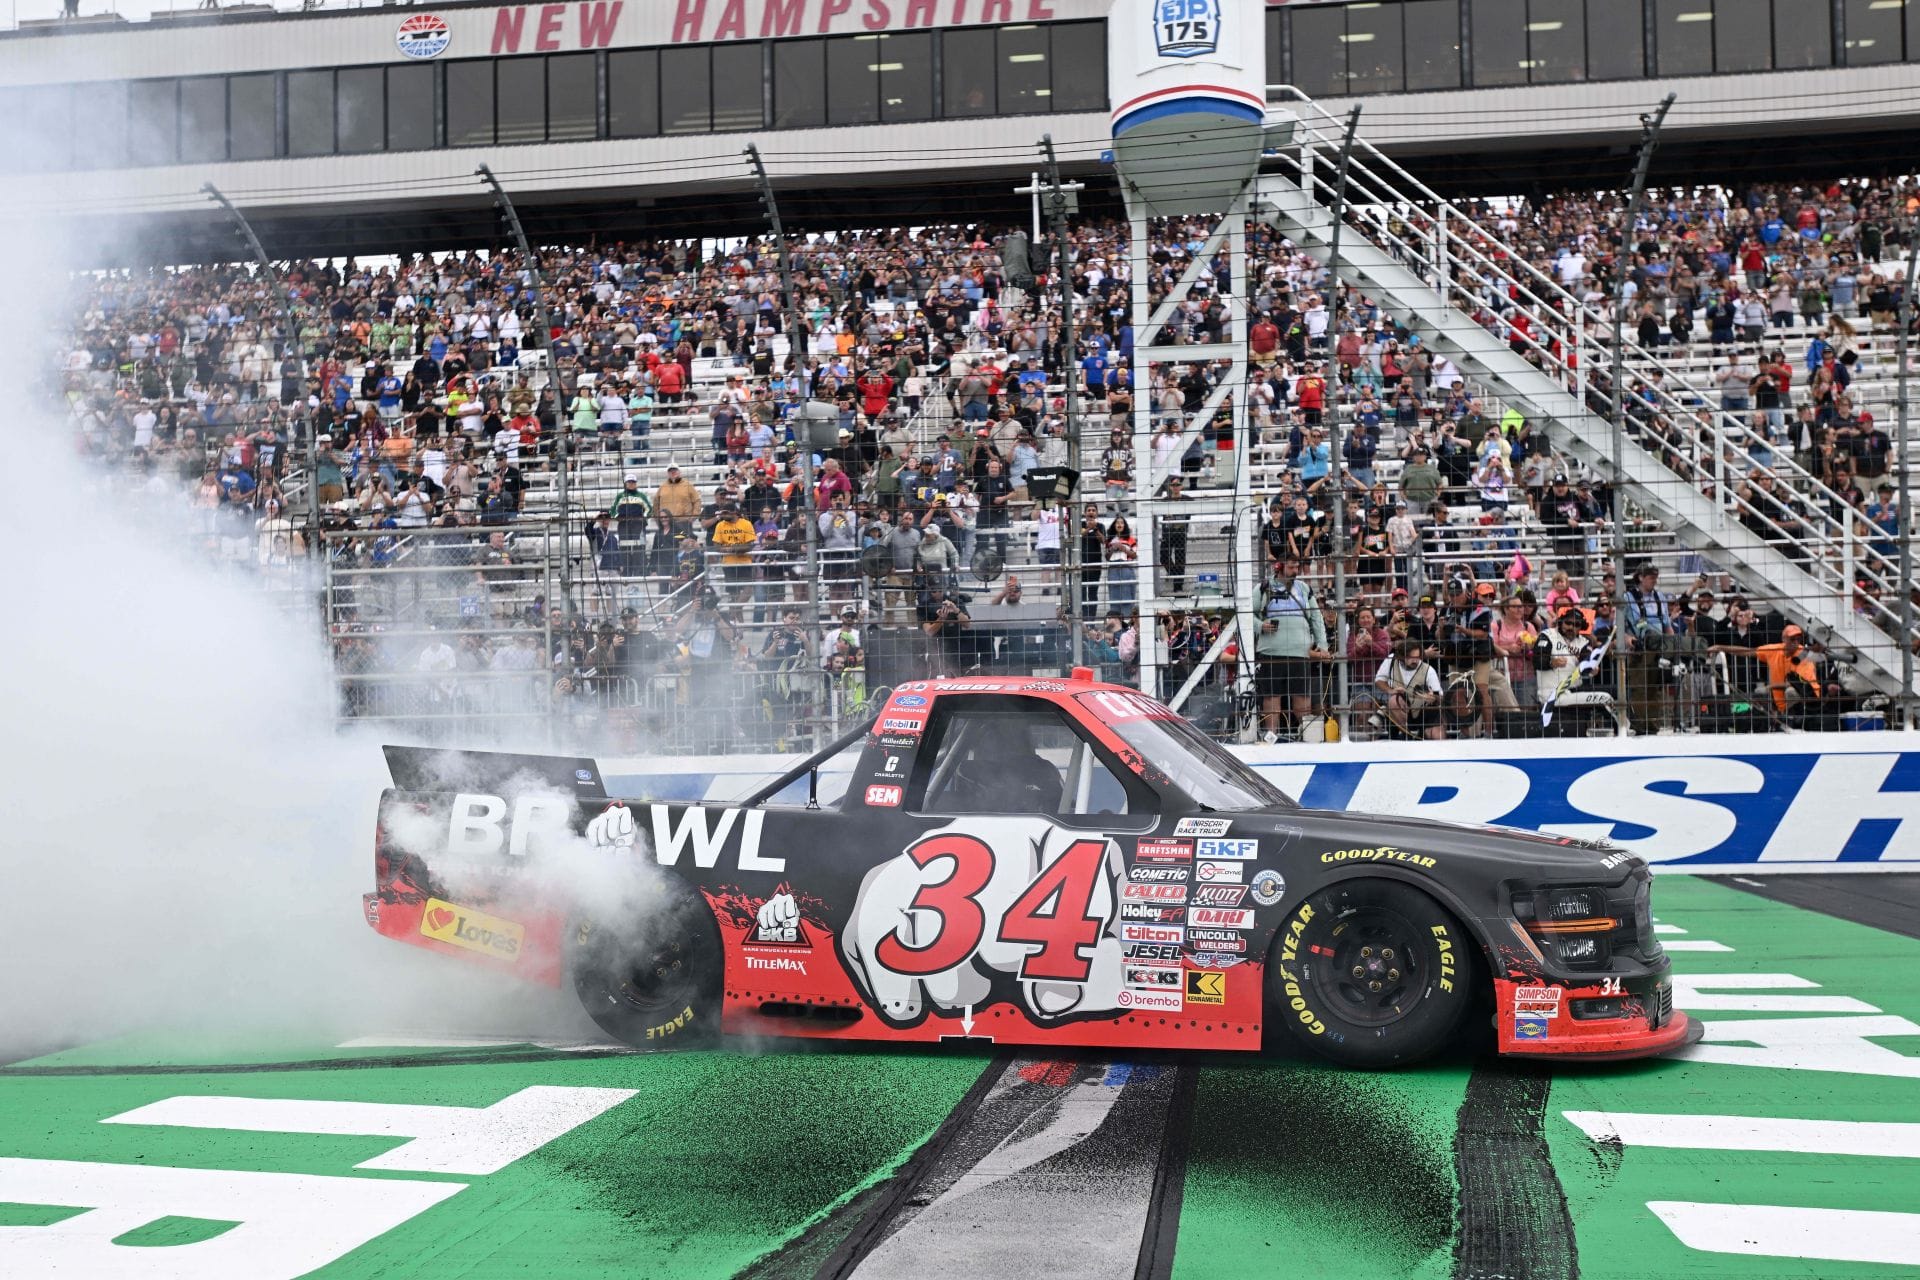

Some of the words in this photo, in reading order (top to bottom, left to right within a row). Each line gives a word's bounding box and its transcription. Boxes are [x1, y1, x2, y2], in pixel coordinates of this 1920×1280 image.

[491, 1, 623, 53] NEW
[1165, 22, 1207, 42] 175
[893, 696, 920, 706] Ford
[885, 720, 909, 729] Mobil
[867, 787, 899, 804] SEM
[1139, 846, 1190, 855] CRAFTSMAN
[1200, 841, 1256, 856] SKF
[1321, 847, 1437, 869] GOODYEAR
[1130, 867, 1188, 880] COMETIC
[1199, 887, 1240, 901] KLOTZ
[873, 832, 1111, 984] 34
[1122, 904, 1162, 921] Holley
[1125, 926, 1180, 942] tilton
[1189, 930, 1236, 941] LINCOLN
[1123, 944, 1183, 961] JESEL
[1199, 941, 1240, 950] WELDERS
[1431, 925, 1455, 994] EAGLE
[1280, 904, 1326, 1036] GOODYEAR
[1517, 988, 1560, 1000] SIMPSON
[1601, 977, 1621, 996] 34
[1134, 996, 1180, 1007] brembo
[1187, 996, 1223, 1004] KENNAMETAL
[1516, 1002, 1557, 1012] ARP
[646, 1005, 695, 1040] EAGLE
[1516, 1024, 1546, 1034] SUNOCO
